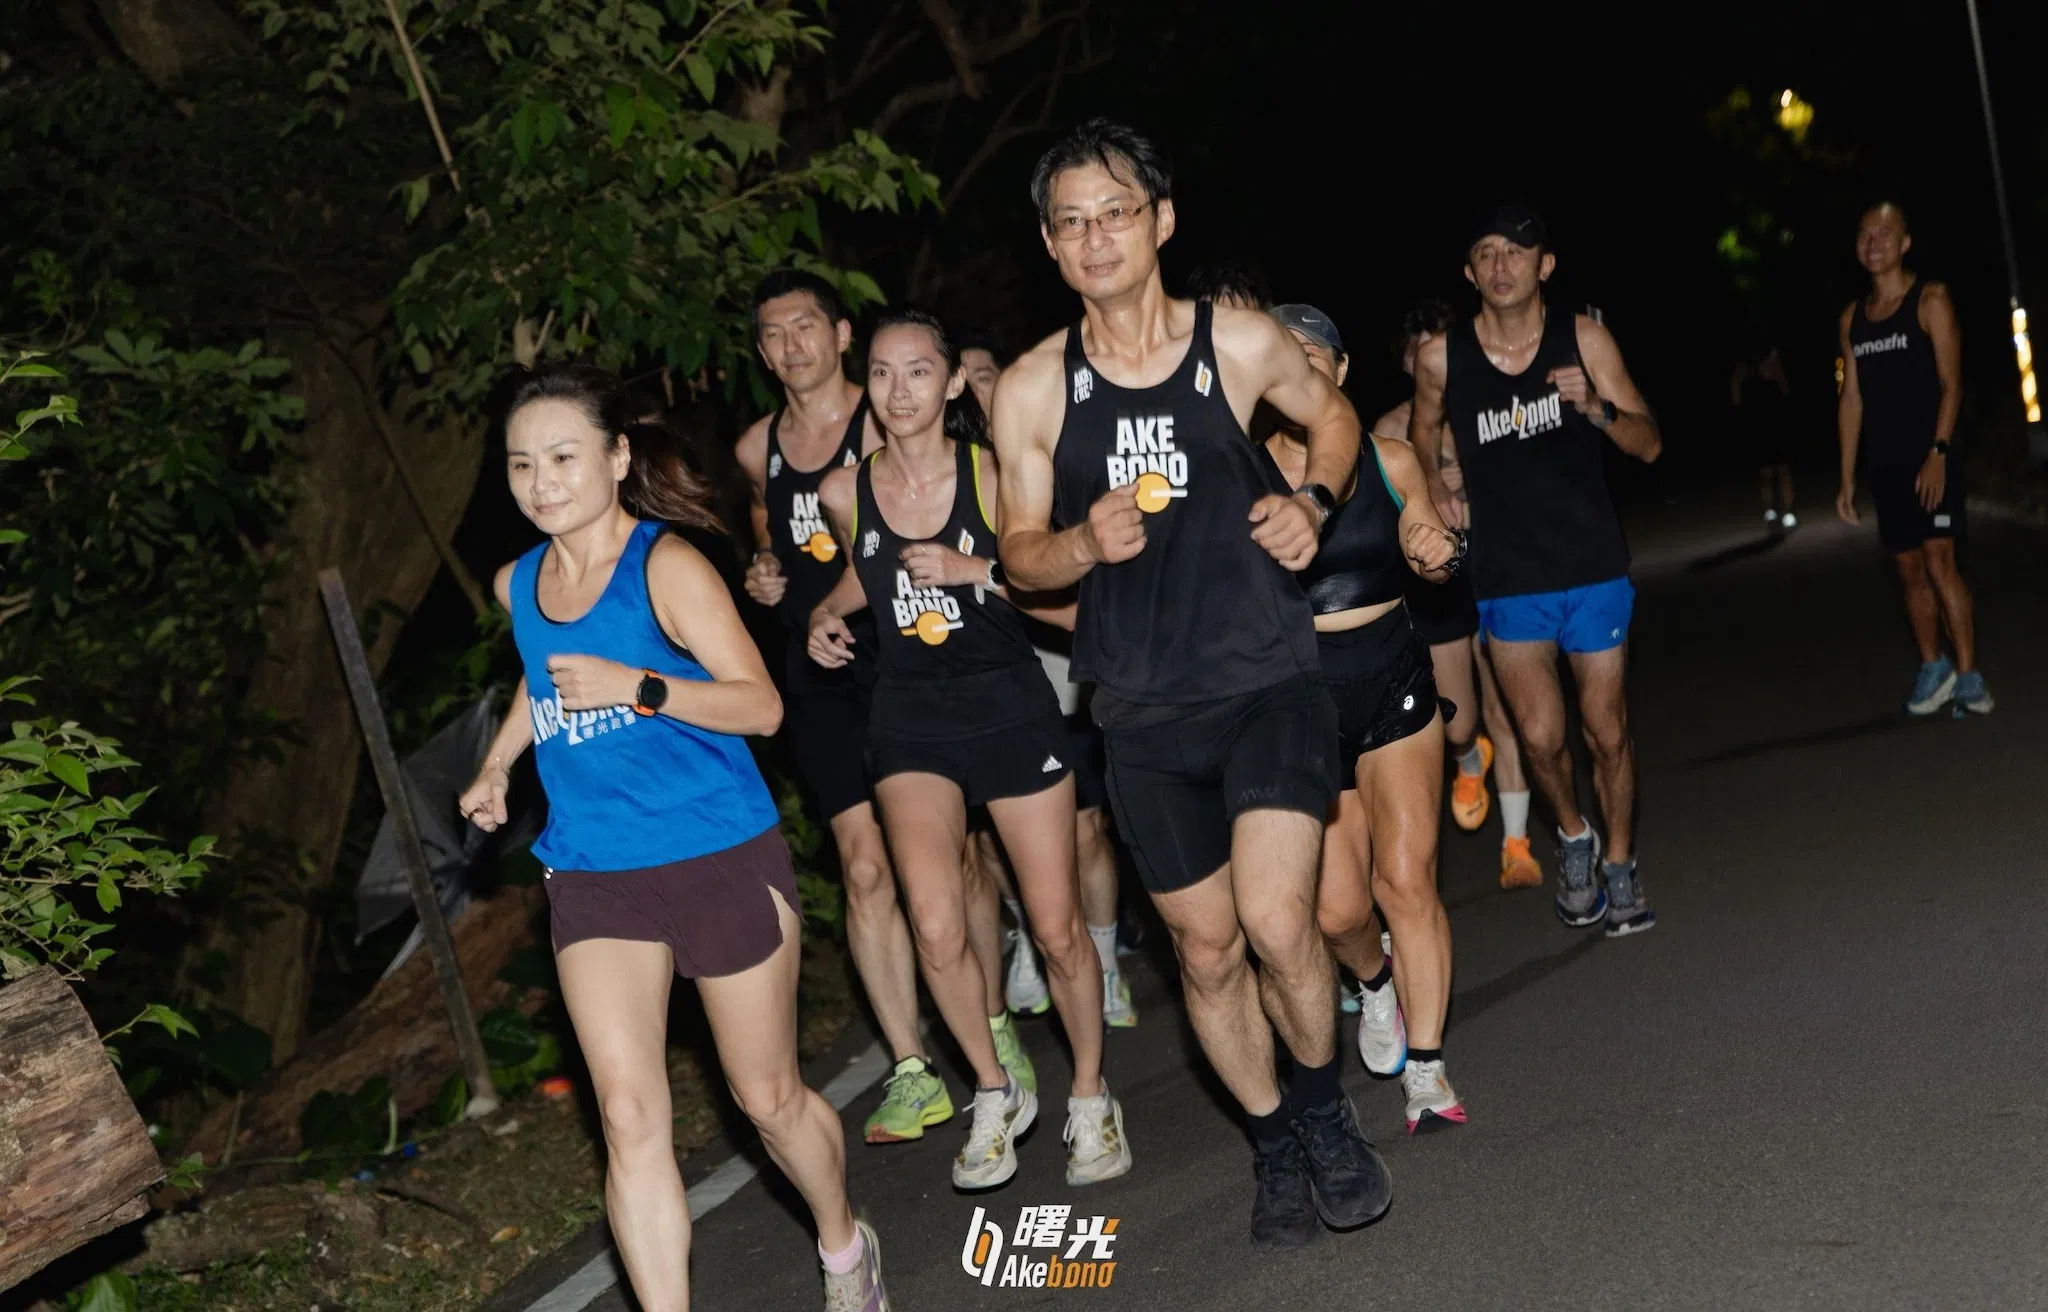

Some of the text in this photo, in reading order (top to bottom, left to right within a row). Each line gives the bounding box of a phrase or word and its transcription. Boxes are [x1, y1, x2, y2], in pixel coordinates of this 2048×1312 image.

[1116, 415, 1176, 456] AKE
[793, 492, 821, 520] AK
[789, 518, 830, 545] BON
